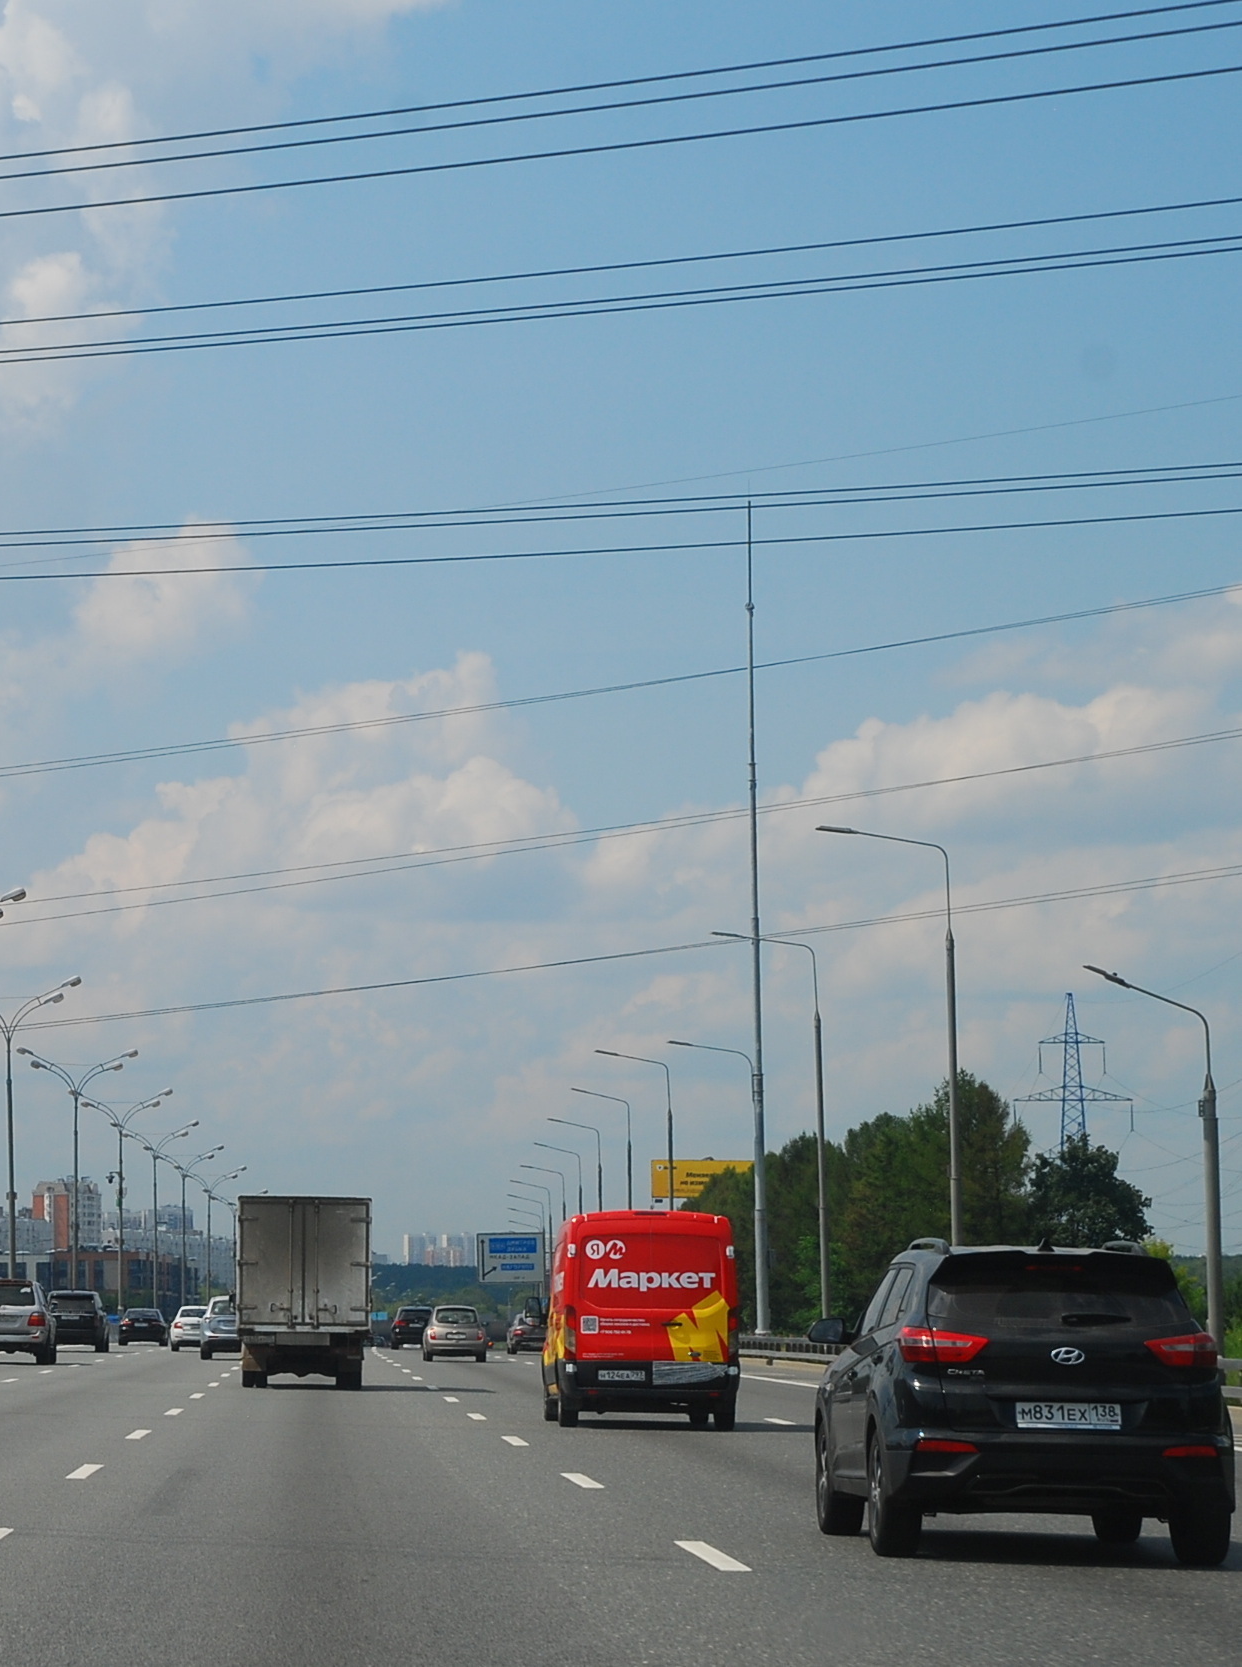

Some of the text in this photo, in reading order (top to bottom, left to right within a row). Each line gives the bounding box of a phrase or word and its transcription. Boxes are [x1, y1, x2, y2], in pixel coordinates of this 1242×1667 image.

[587, 1268, 716, 1292] Маркет
[1021, 1404, 1115, 1421] М831ЕХ 138
